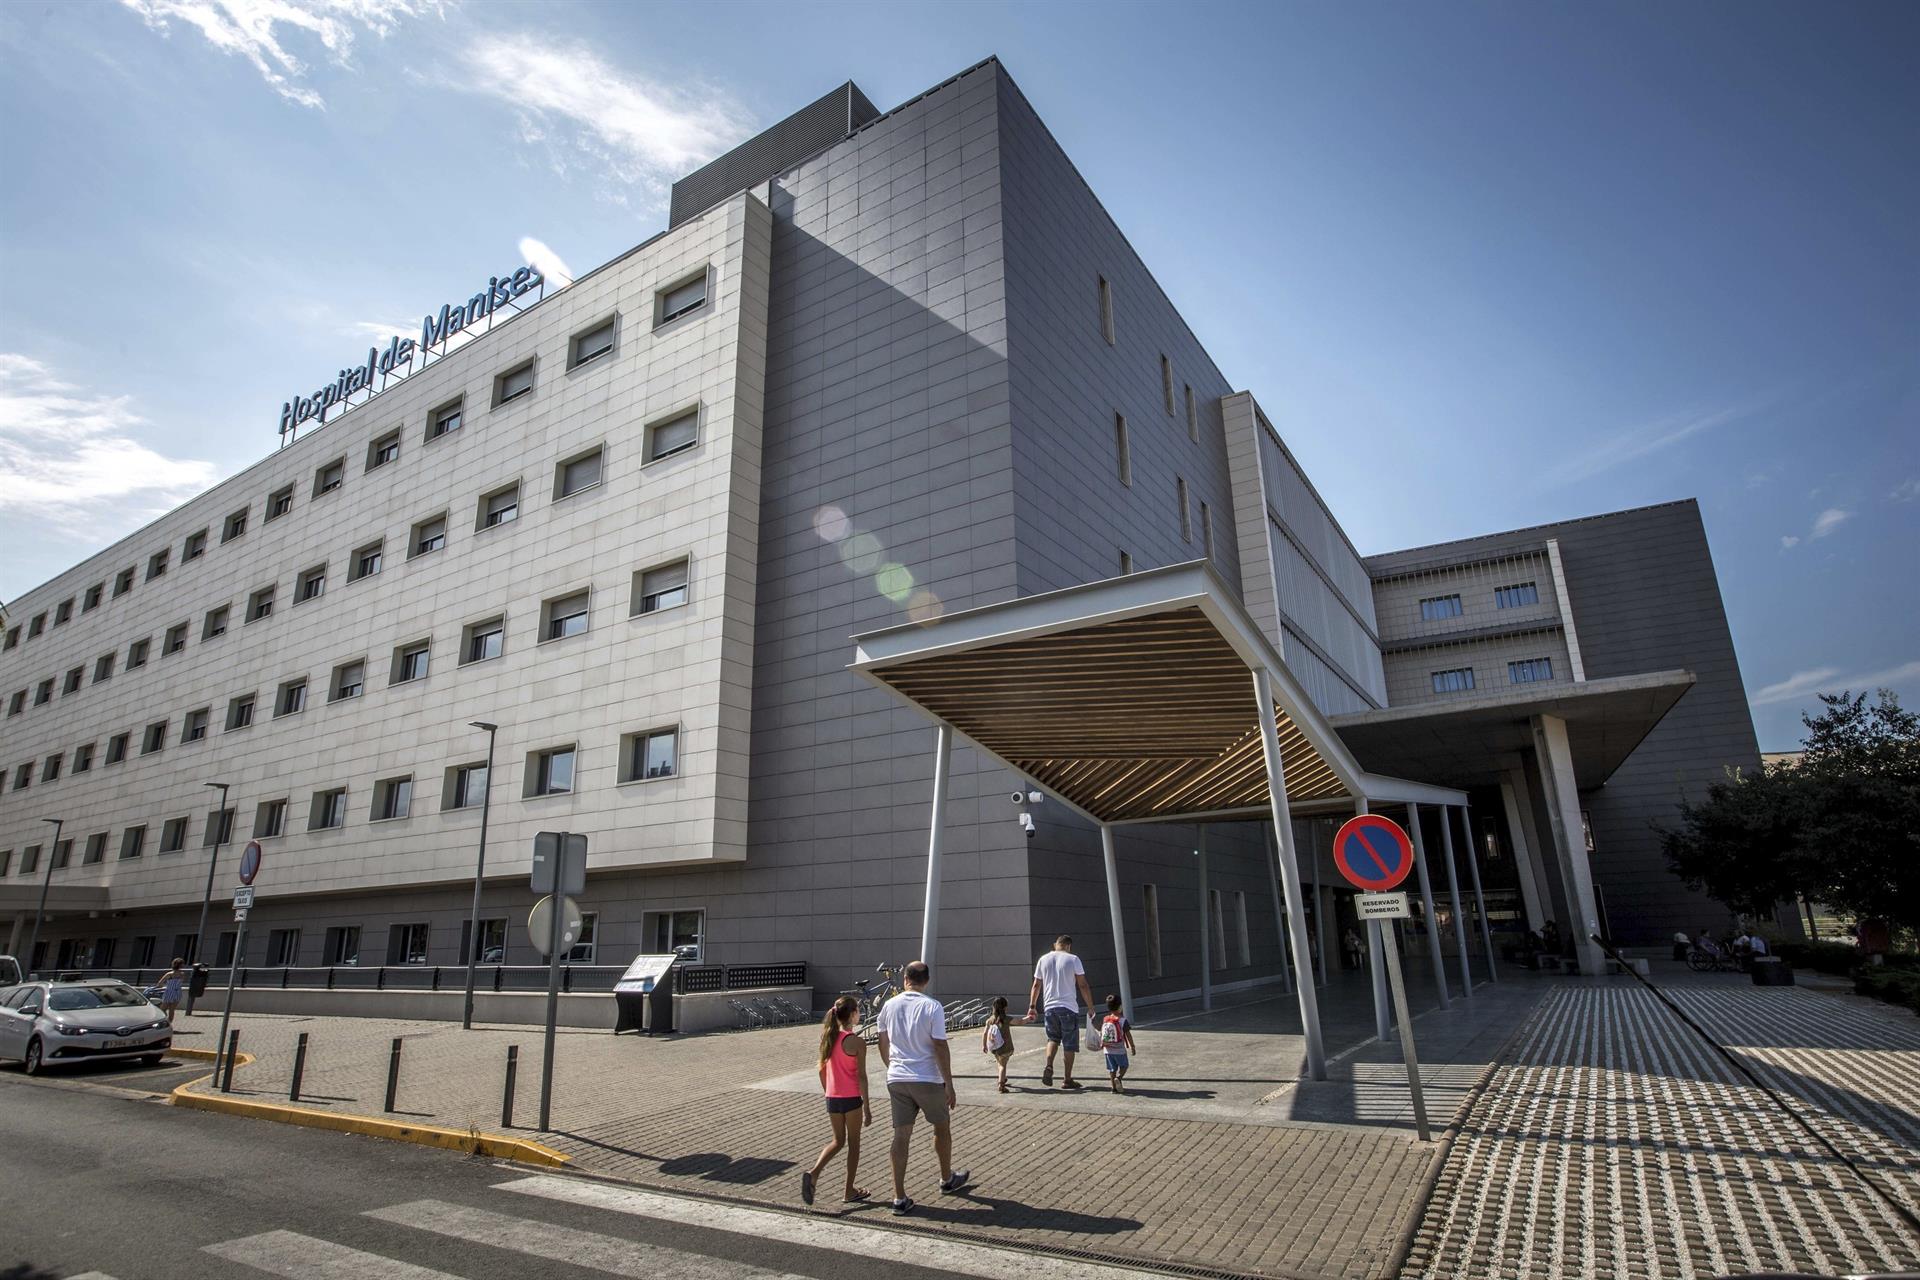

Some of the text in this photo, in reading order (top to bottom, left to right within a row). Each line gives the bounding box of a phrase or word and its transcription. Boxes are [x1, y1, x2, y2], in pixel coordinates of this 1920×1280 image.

[278, 347, 378, 434] Hospital
[378, 335, 415, 375] de
[1362, 899, 1400, 907] RESERVADO
